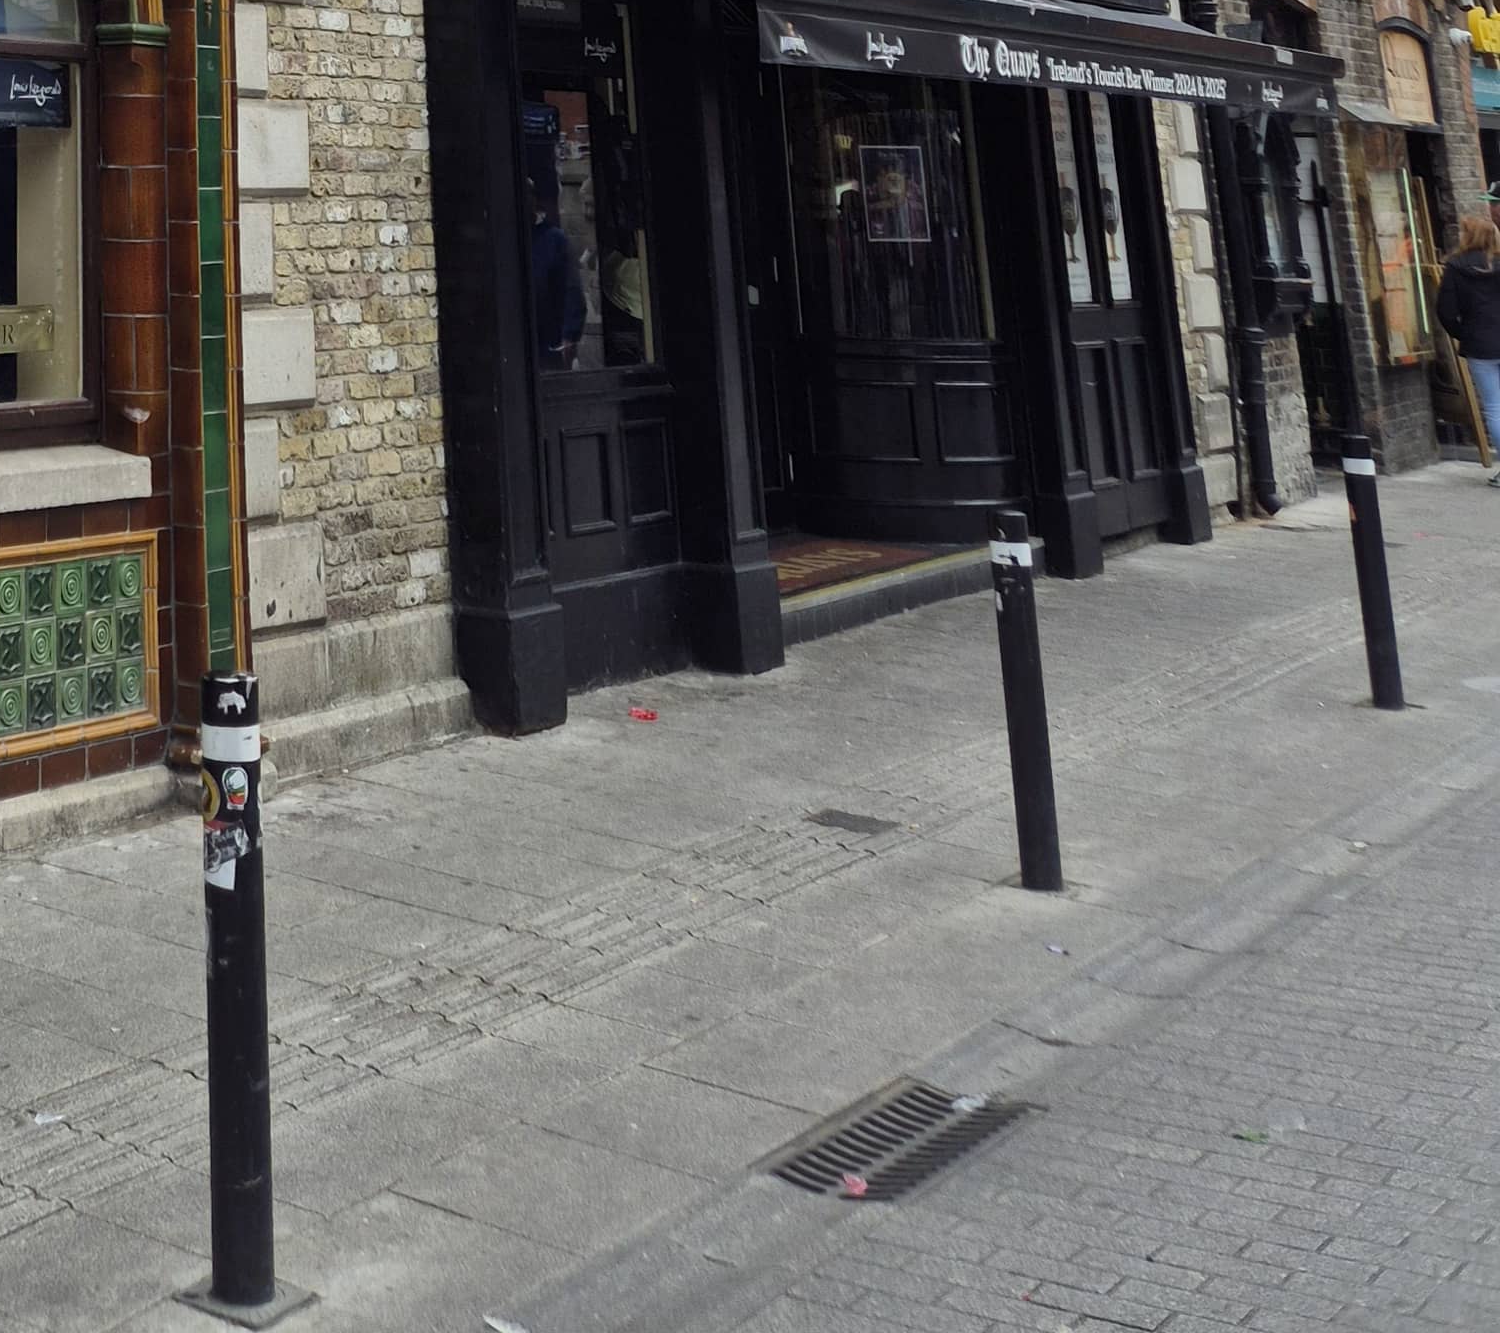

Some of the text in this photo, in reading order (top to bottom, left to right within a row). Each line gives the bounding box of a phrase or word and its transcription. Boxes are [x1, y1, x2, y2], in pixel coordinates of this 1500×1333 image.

[959, 34, 991, 82] The
[994, 37, 1041, 83] Quays
[1090, 61, 1126, 88] Tourist
[1123, 65, 1143, 90] Bar
[1140, 68, 1176, 94] Winner
[1173, 72, 1198, 97] 2024
